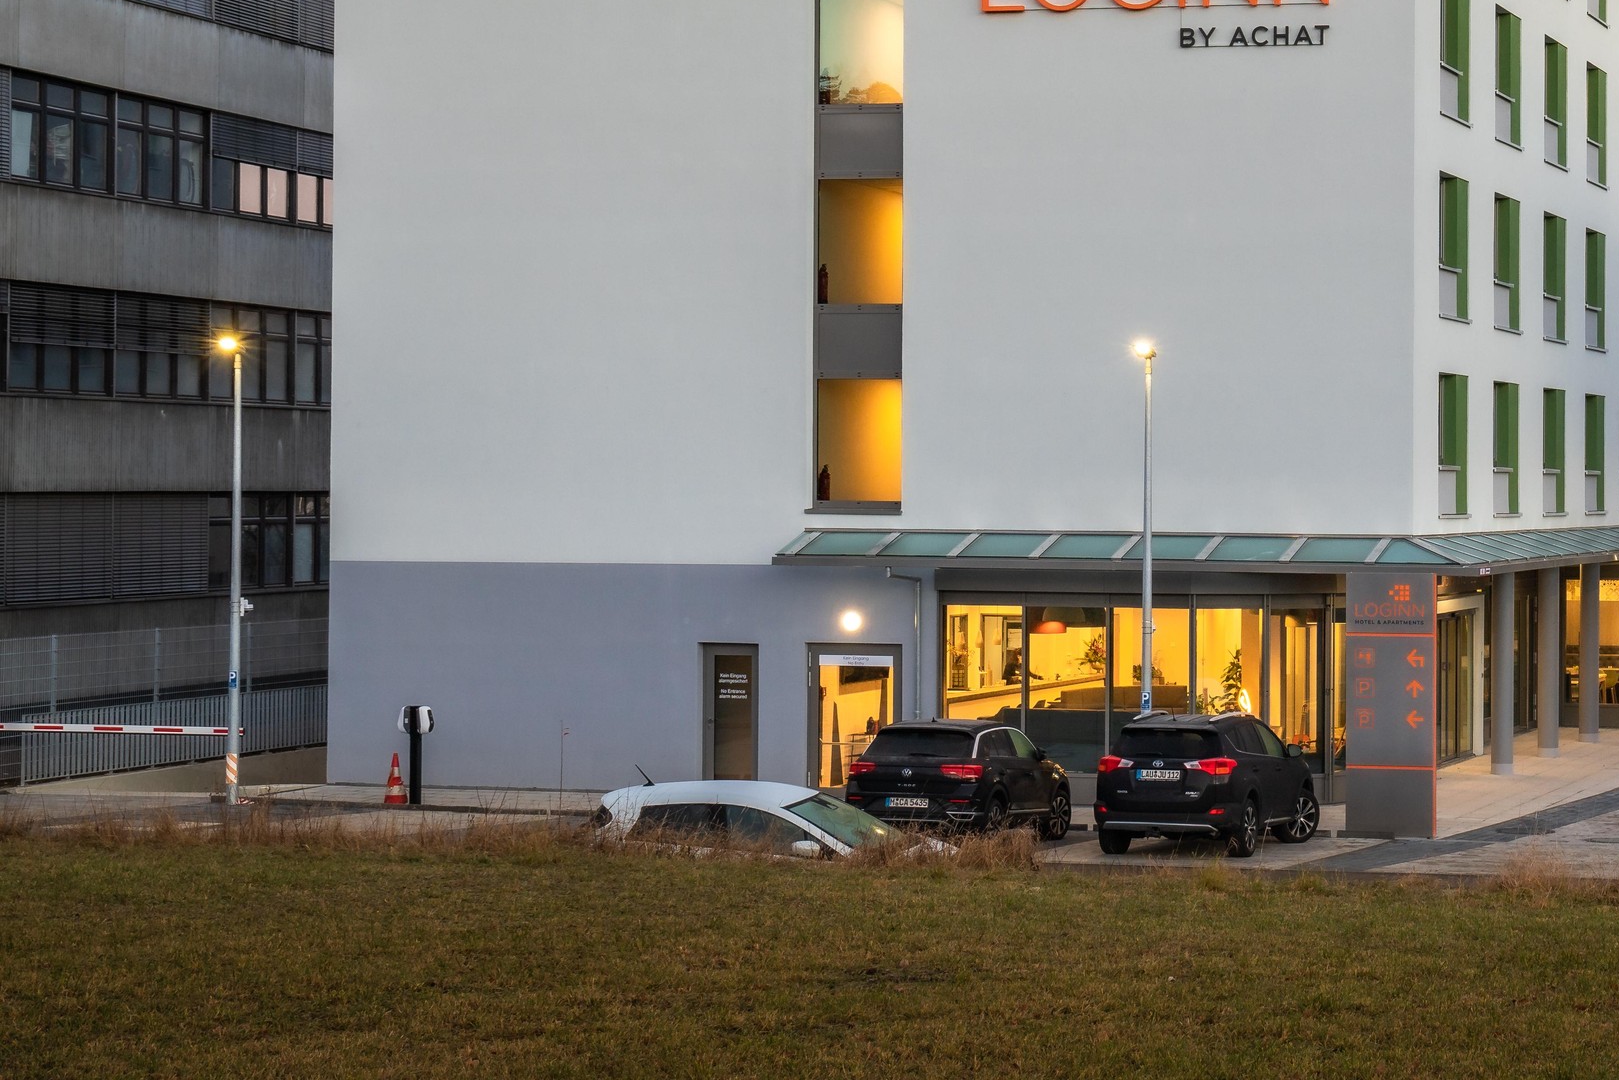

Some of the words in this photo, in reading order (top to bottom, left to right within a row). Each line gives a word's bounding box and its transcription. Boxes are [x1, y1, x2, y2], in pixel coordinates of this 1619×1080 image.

[1180, 27, 1215, 48] BY
[1229, 24, 1330, 47] ACHAT
[1354, 602, 1425, 618] LOGINN
[229, 671, 236, 682] P
[1142, 692, 1150, 704] P
[1141, 769, 1154, 778] LAU
[910, 799, 928, 807] 5435
